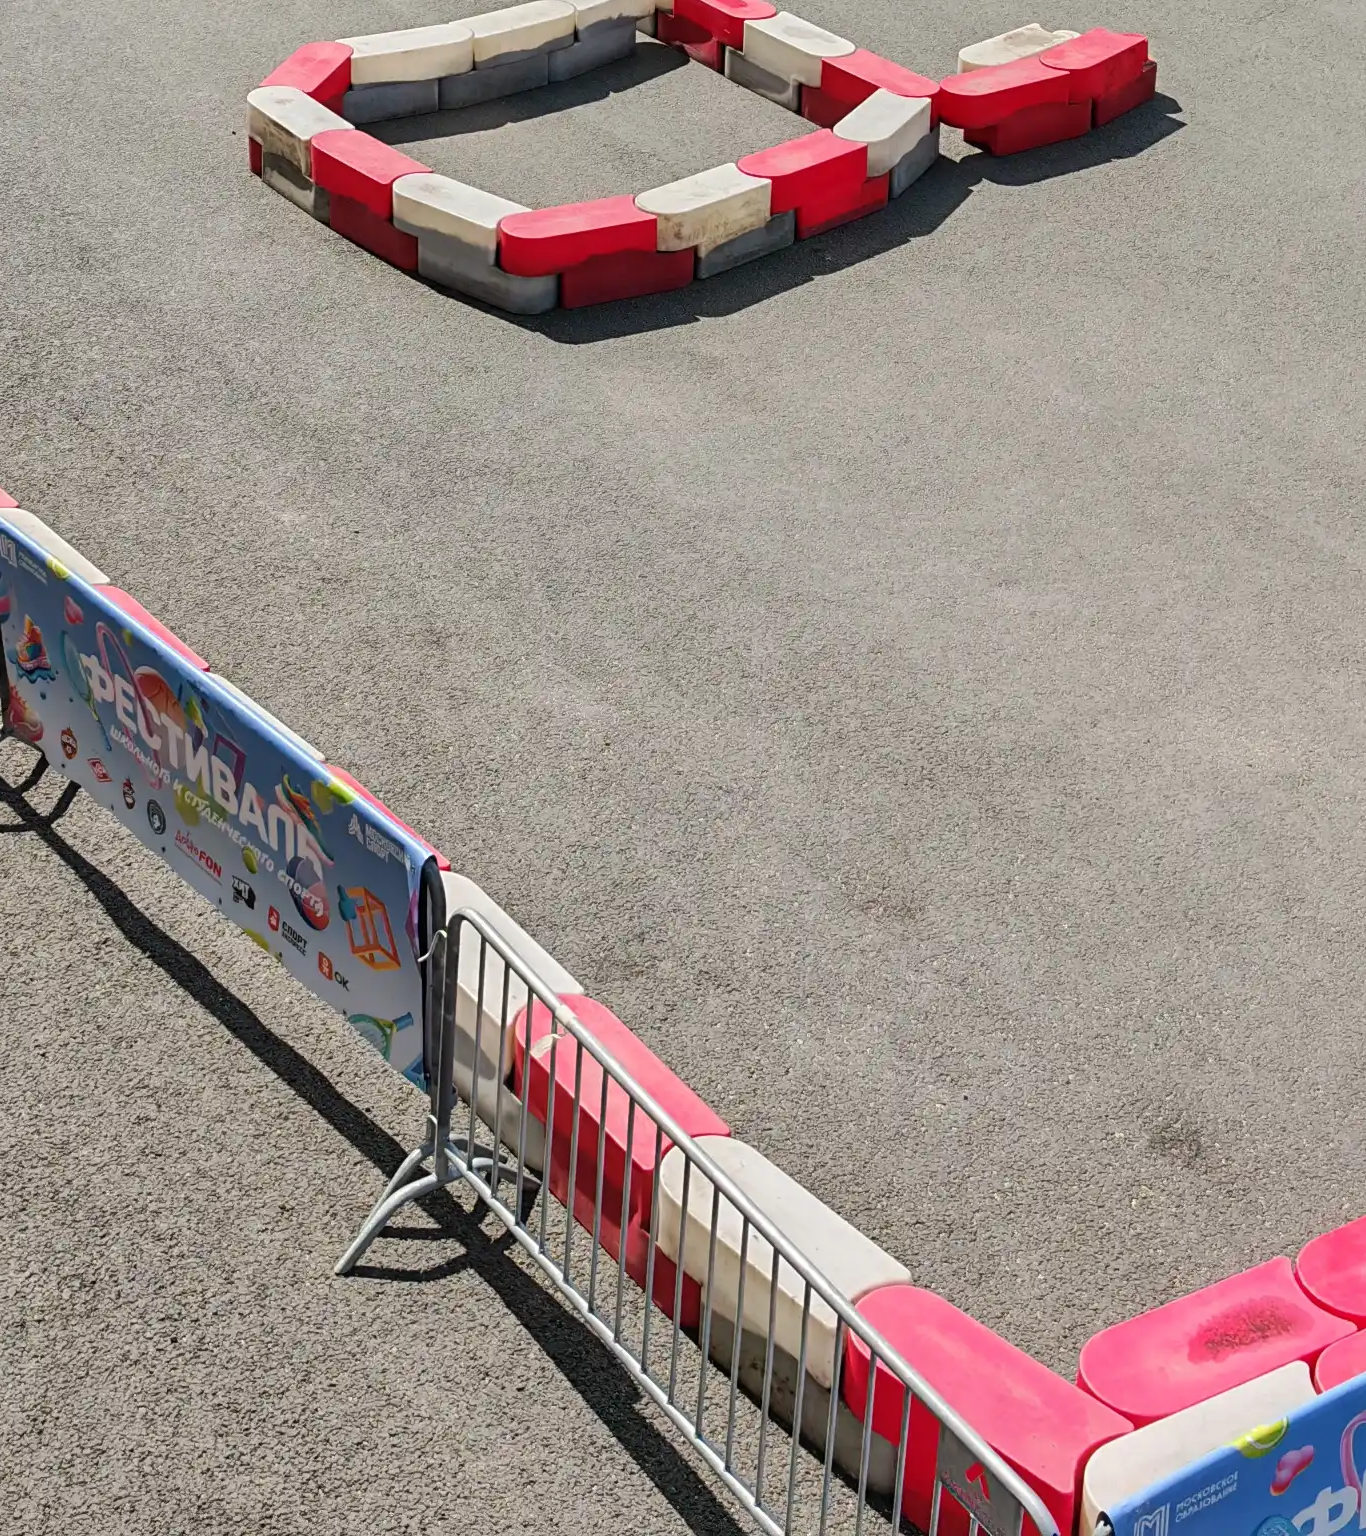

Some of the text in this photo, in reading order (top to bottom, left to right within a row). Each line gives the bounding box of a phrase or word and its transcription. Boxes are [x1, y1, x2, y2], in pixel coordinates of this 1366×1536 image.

[79, 652, 325, 879] ФЕСТИВАЛЬ
[282, 920, 308, 949] СПОРТ
[1175, 1482, 1238, 1523] ОБРАЗОВАНИЕ
[1176, 1471, 1238, 1510] МОСКОВСКОЕ
